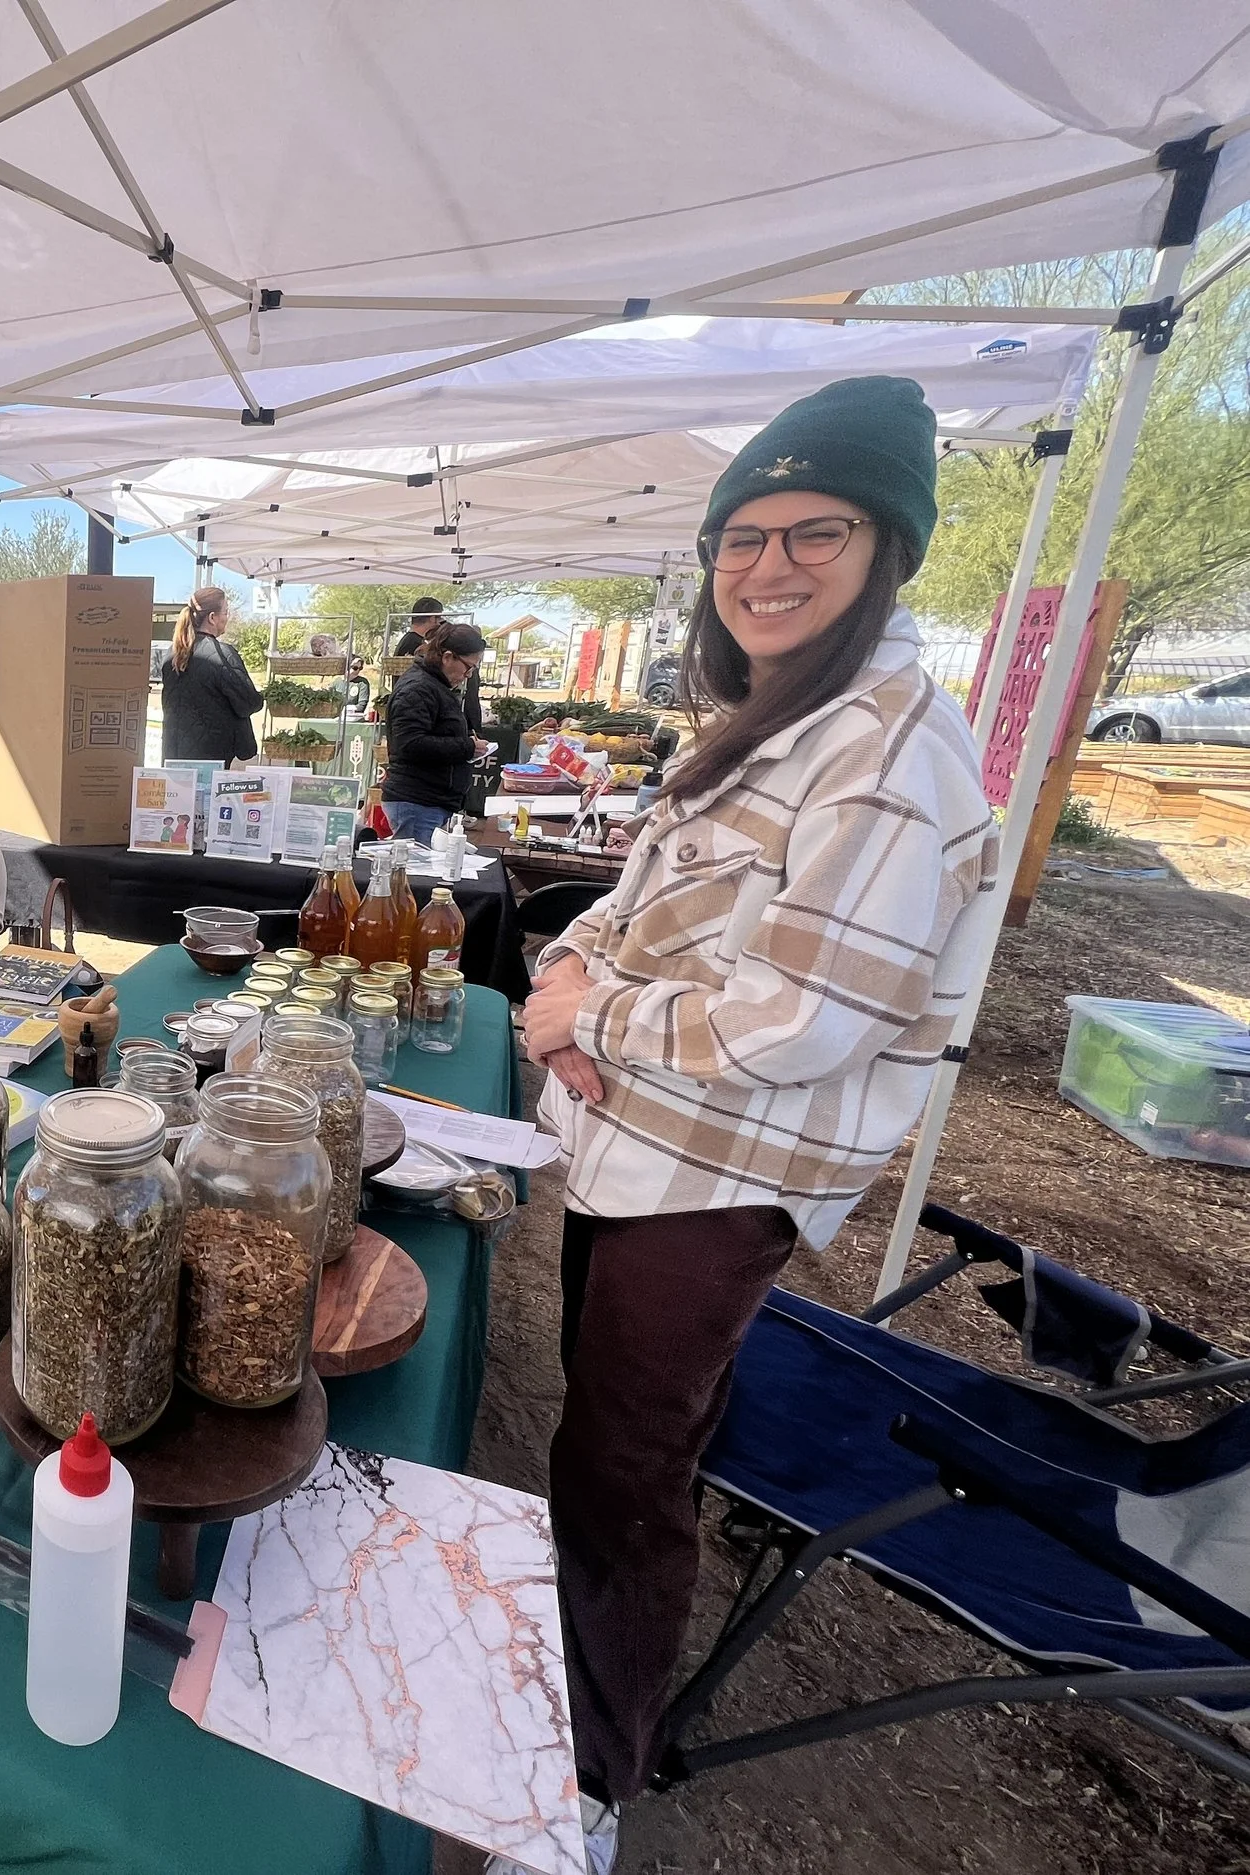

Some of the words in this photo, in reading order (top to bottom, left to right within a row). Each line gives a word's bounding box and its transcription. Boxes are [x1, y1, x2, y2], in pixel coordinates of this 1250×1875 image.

[72, 646, 120, 654] Presentation
[122, 647, 144, 655] Board
[221, 783, 247, 791] Follow
